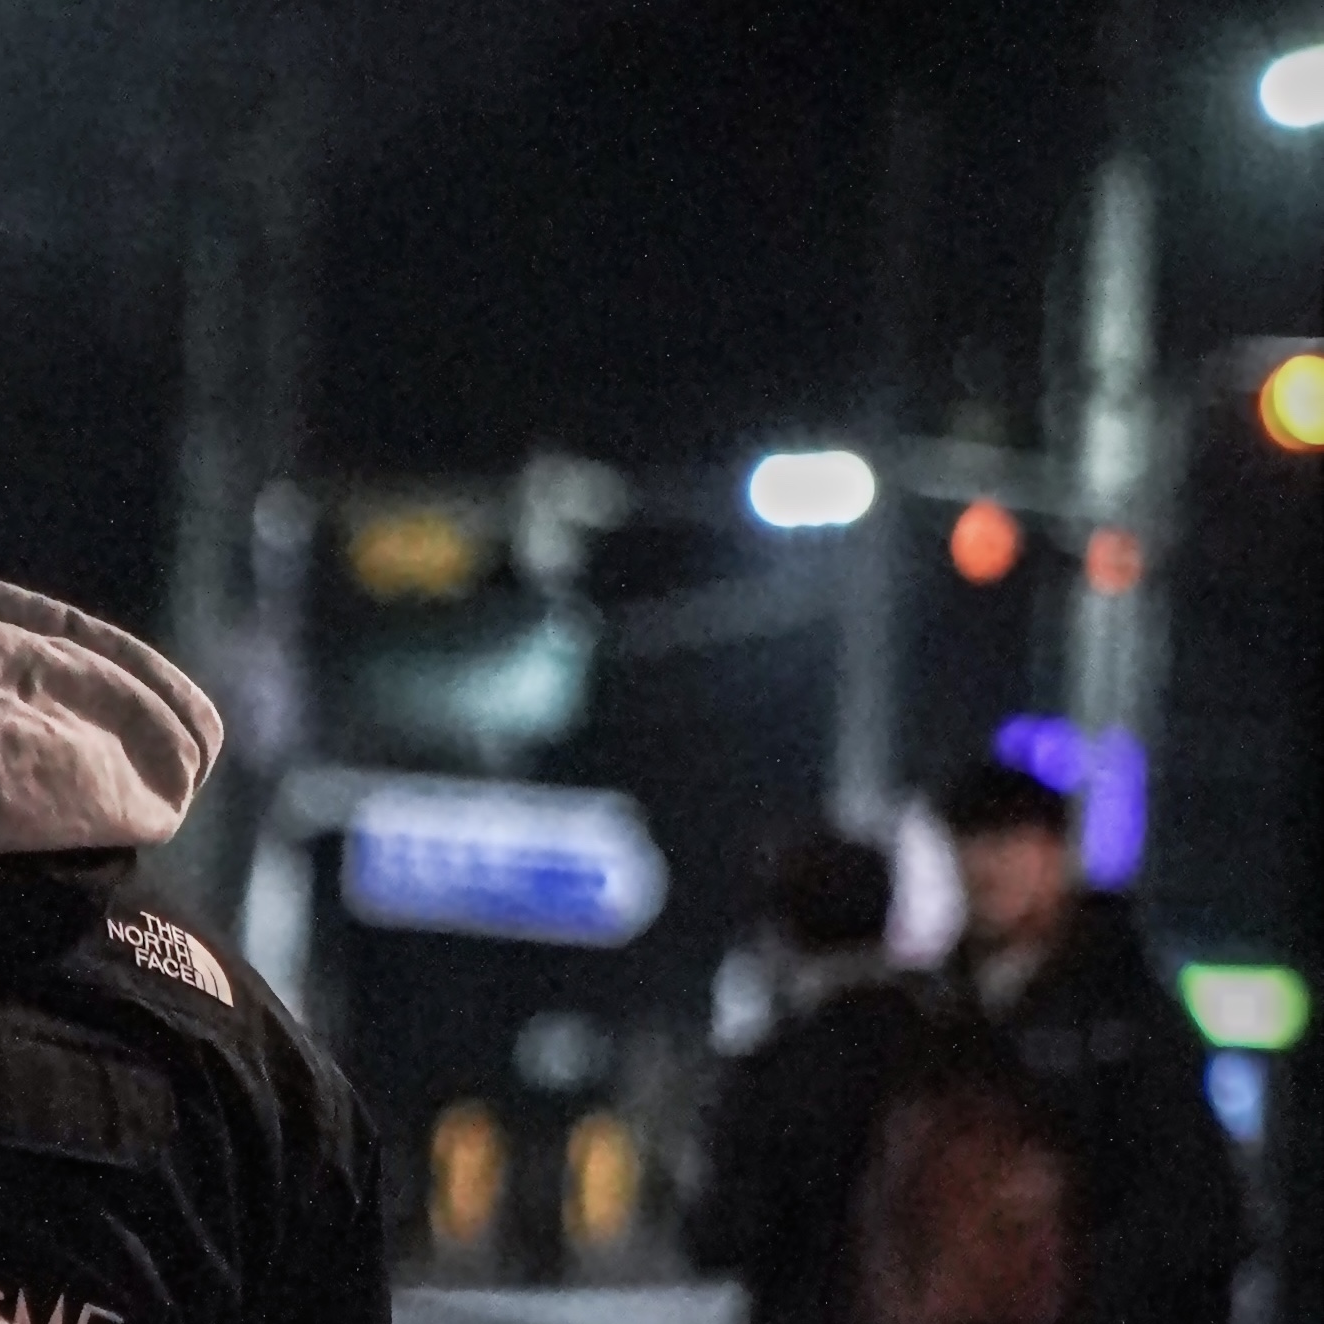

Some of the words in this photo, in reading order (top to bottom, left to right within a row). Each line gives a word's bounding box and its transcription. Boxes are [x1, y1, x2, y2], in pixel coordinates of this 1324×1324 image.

[106, 918, 191, 966] NORTH
[139, 910, 187, 946] THE
[134, 947, 197, 987] FACE
